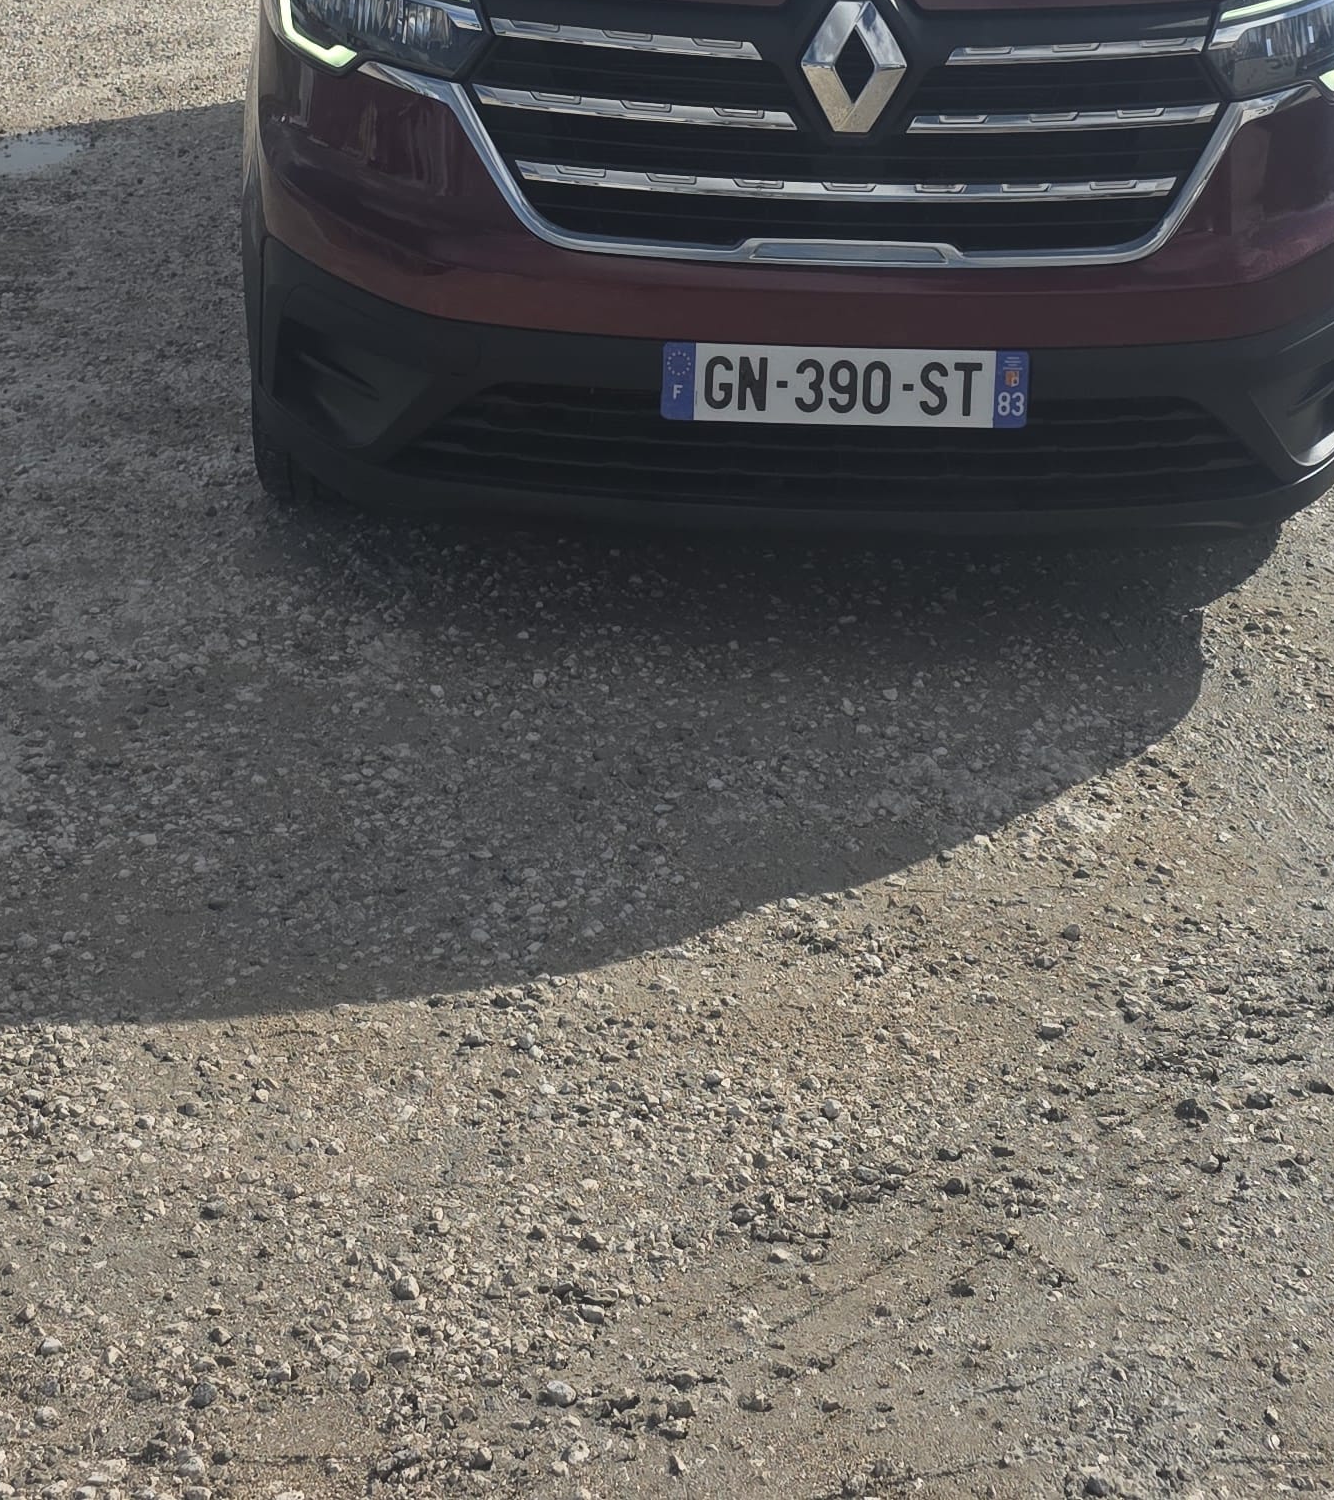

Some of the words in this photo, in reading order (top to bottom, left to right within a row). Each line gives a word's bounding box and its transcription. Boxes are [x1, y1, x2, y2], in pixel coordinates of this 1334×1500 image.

[673, 384, 683, 400] F
[704, 355, 983, 417] GN-390-ST
[998, 391, 1025, 417] 83
